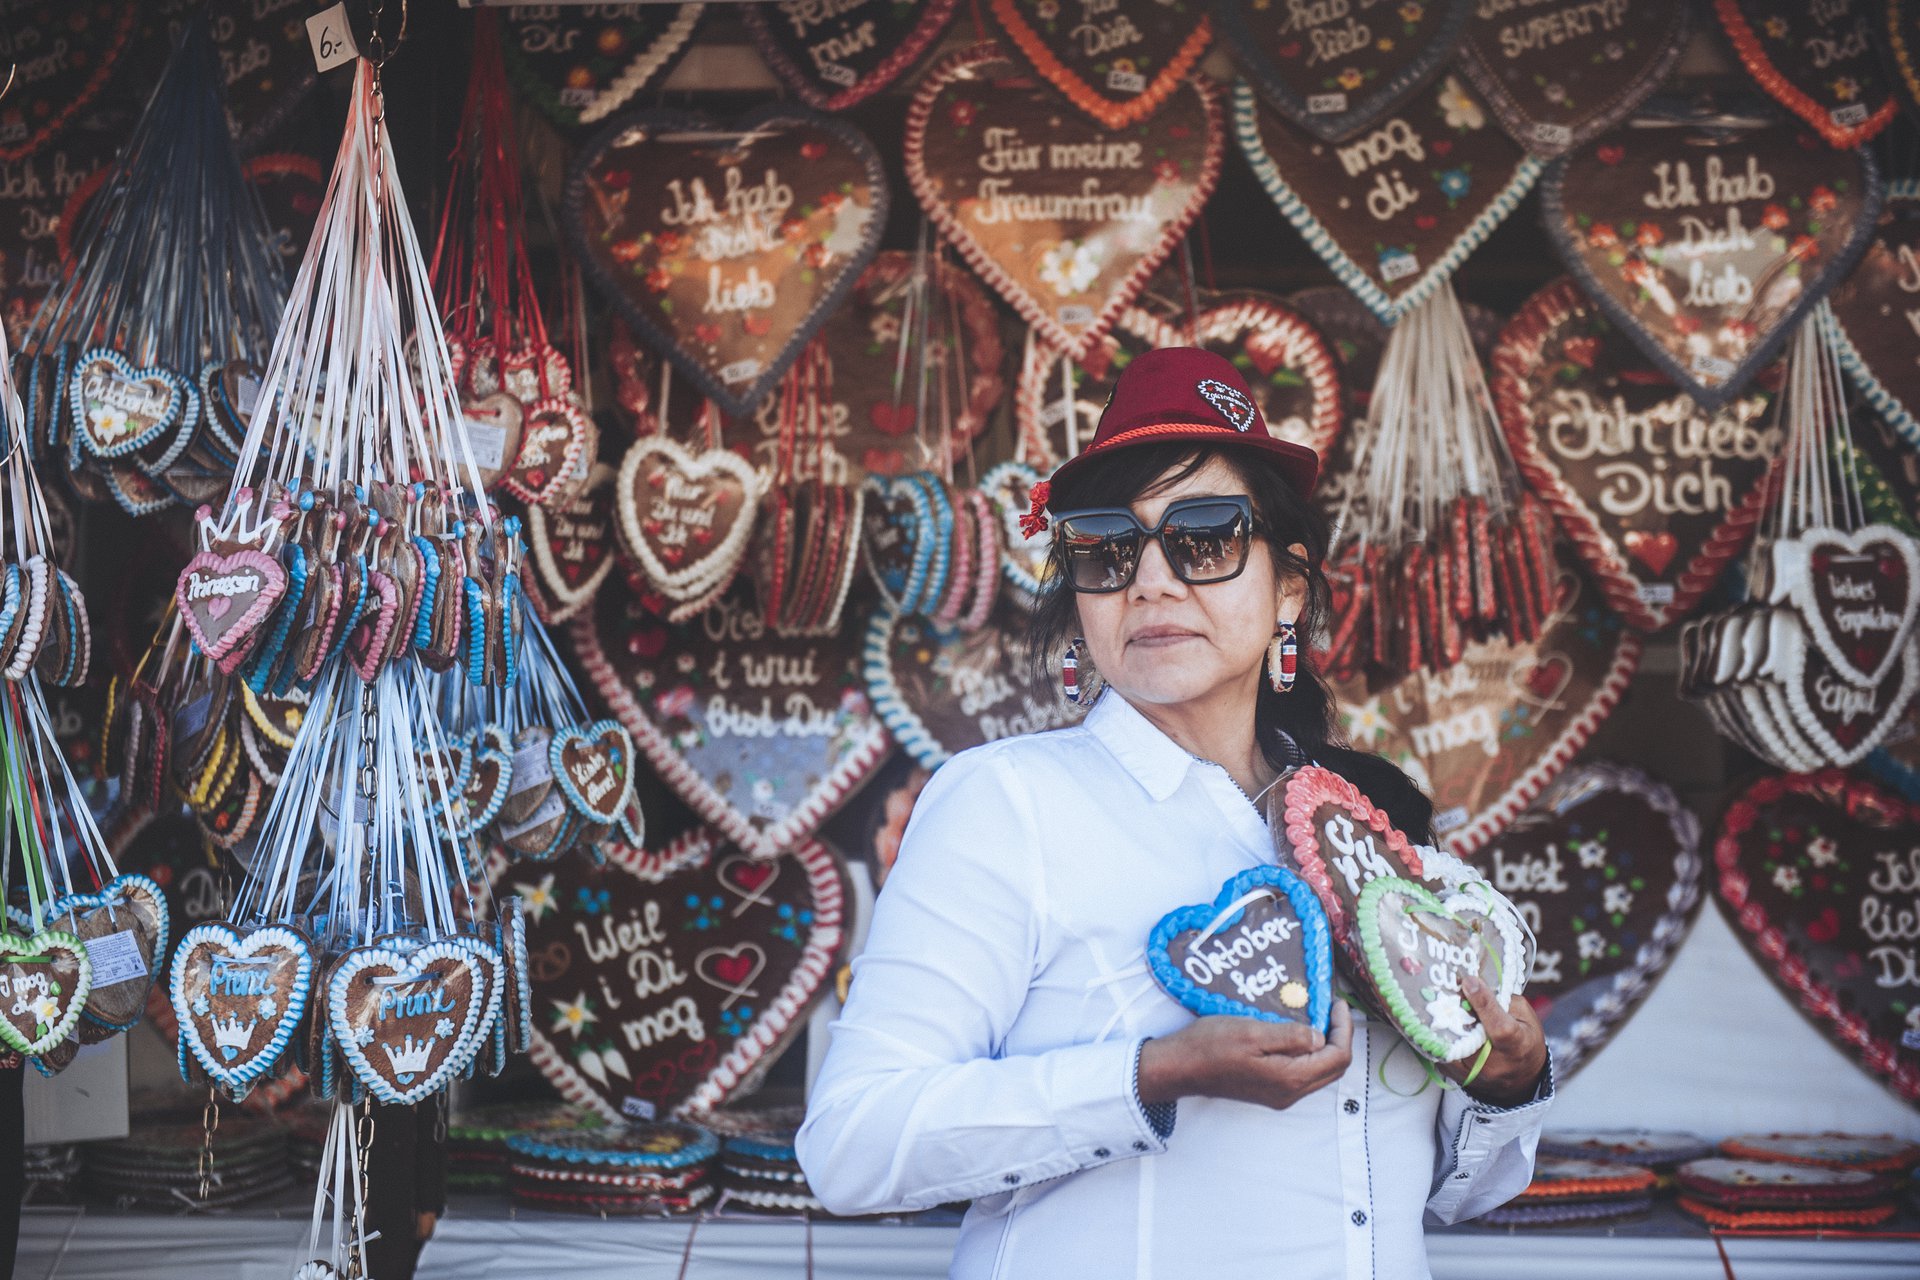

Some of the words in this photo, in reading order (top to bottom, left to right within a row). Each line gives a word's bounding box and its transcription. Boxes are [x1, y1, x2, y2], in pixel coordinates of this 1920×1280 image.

[978, 126, 1042, 172] Für
[1049, 132, 1143, 170] meine
[1337, 118, 1427, 177] mog
[725, 165, 795, 217] hab
[974, 177, 1155, 225] Traumfrau
[1366, 169, 1420, 221] di
[1706, 155, 1776, 204] hab
[1679, 207, 1756, 253] Dich
[703, 264, 776, 313] lieb
[1685, 260, 1753, 306] lieb
[1550, 388, 1666, 460] Ich
[1664, 393, 1776, 460] liebe
[1595, 458, 1733, 515] Dich
[187, 569, 260, 602] Prinzessin
[705, 694, 778, 738] bist
[784, 692, 838, 738] Du
[1410, 704, 1499, 758] mog
[1493, 845, 1567, 893] bist
[574, 900, 667, 963] Weil
[1862, 896, 1920, 940] lie
[598, 974, 621, 1010] i
[627, 947, 688, 998] Di
[1230, 955, 1290, 1002] fest
[1427, 935, 1480, 977] mog
[1429, 962, 1462, 993] di
[12, 972, 49, 996] mog
[621, 996, 705, 1051] mog
